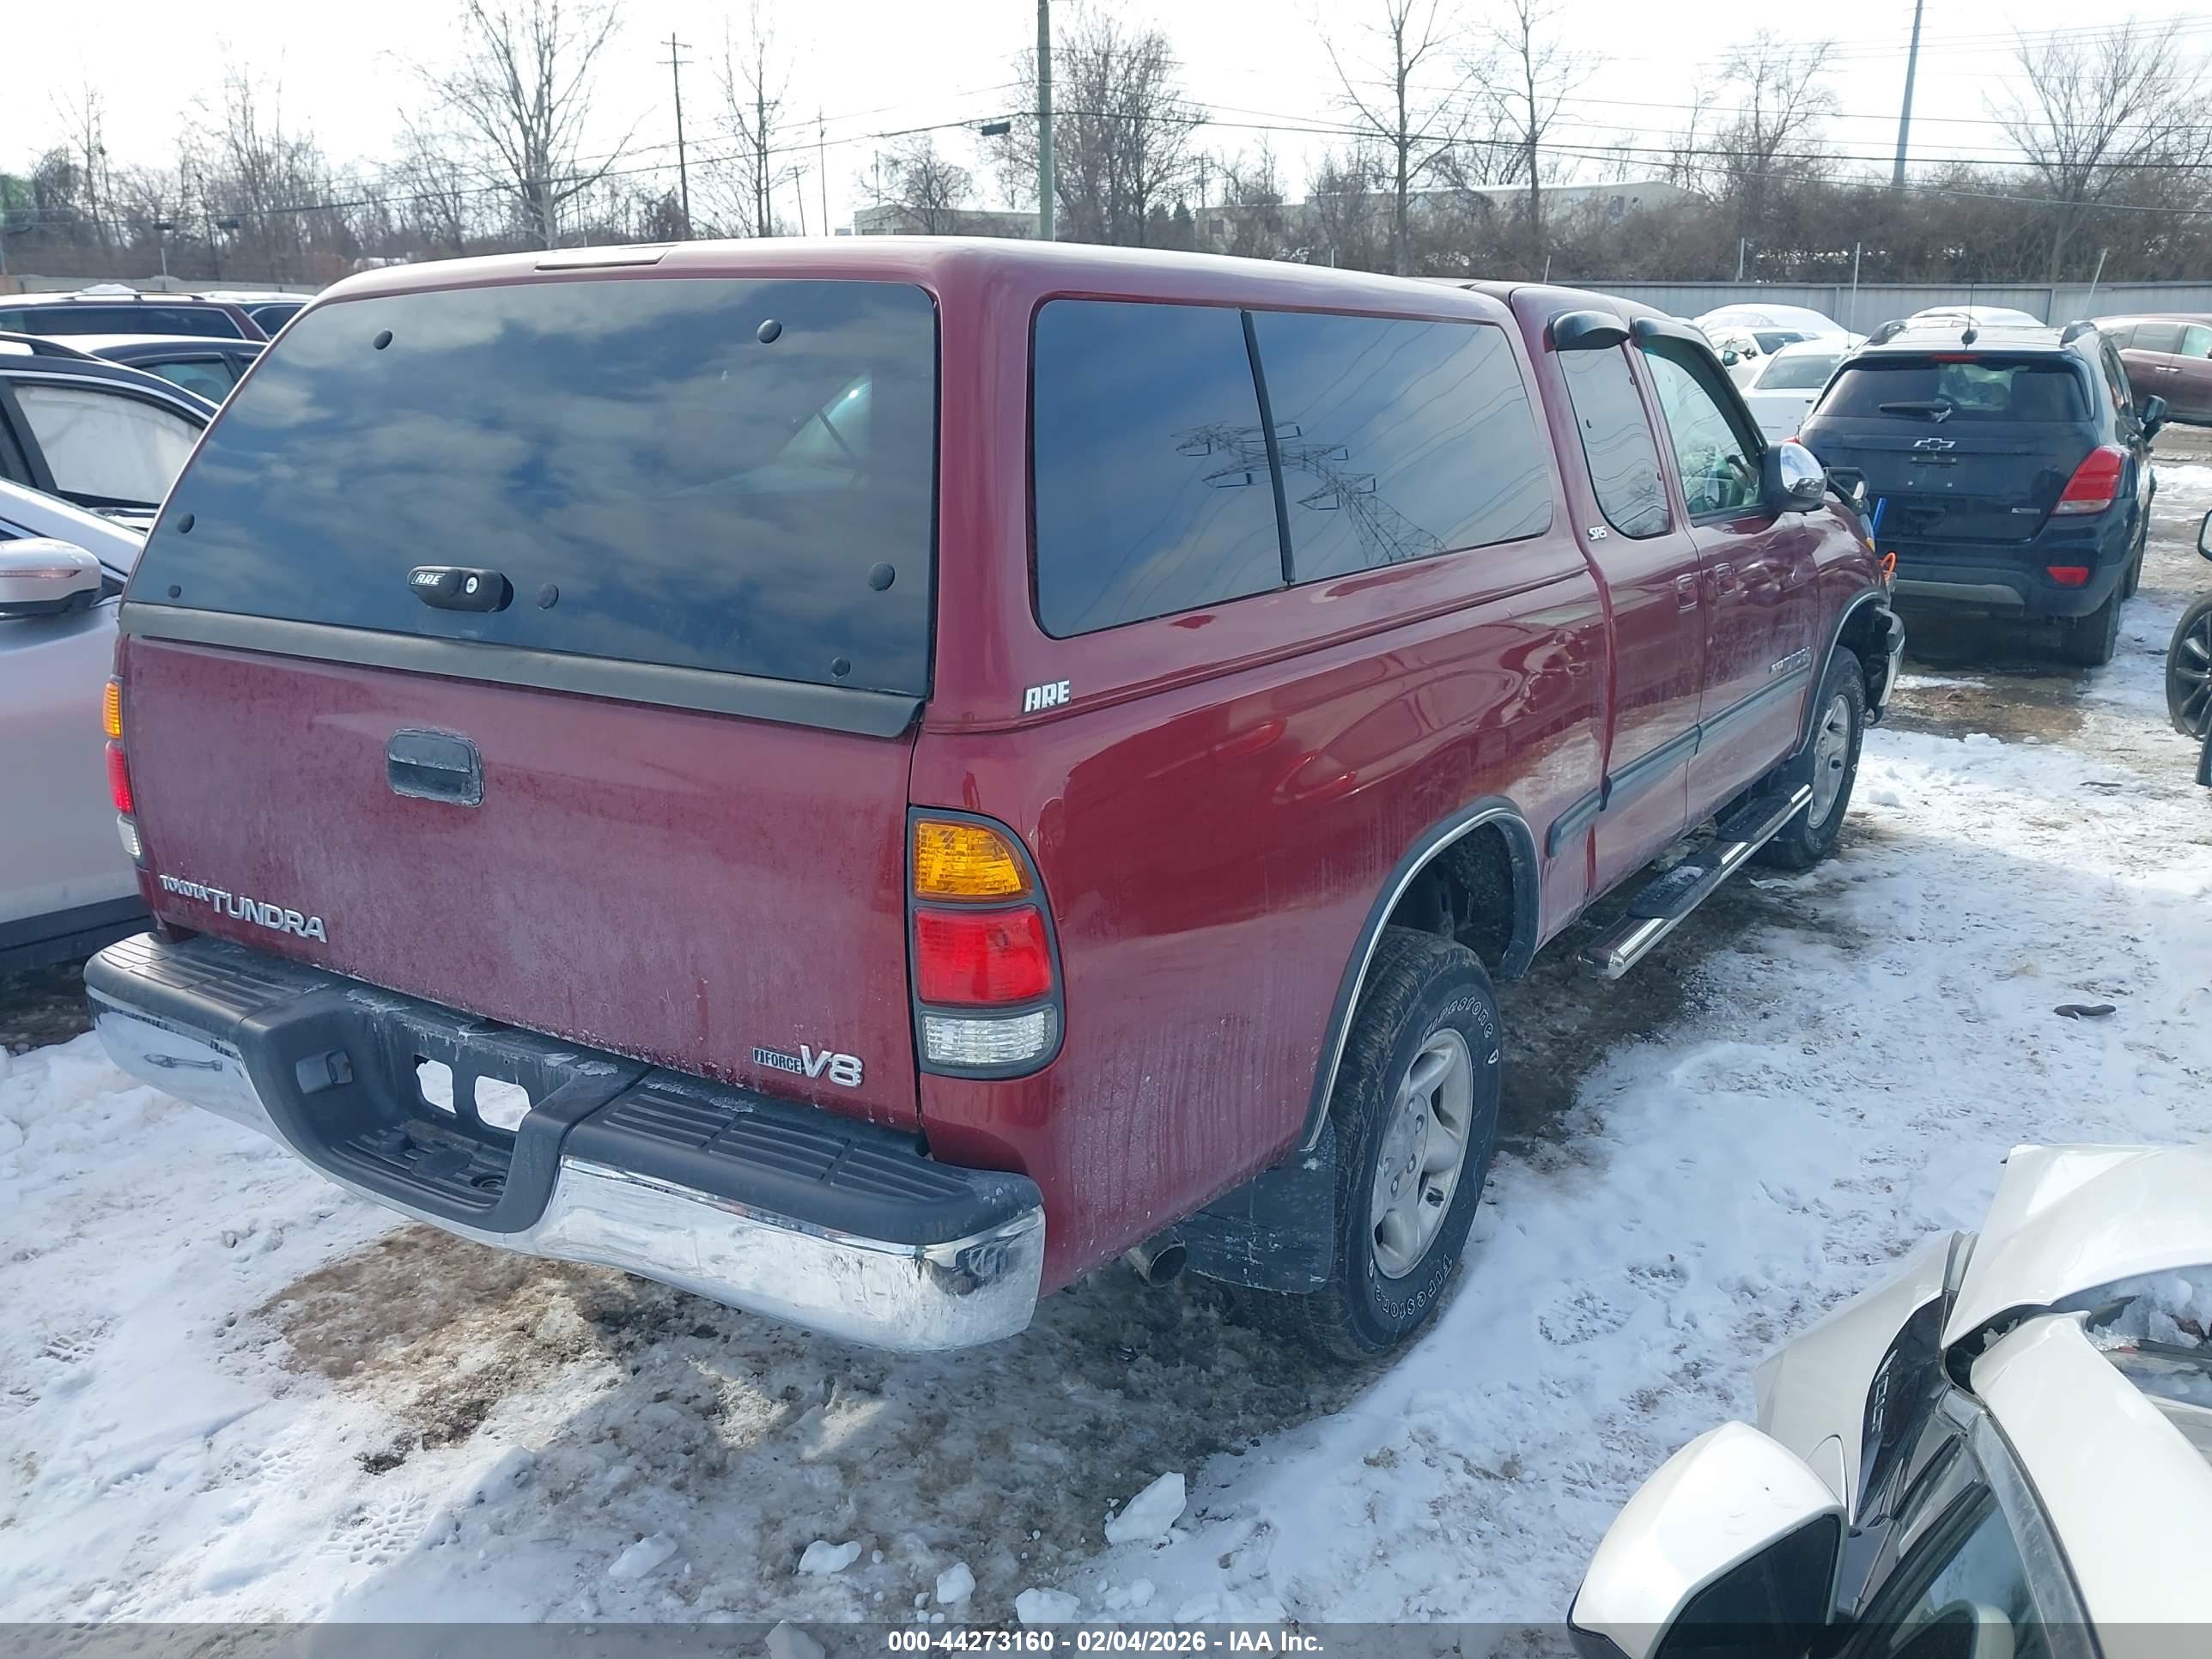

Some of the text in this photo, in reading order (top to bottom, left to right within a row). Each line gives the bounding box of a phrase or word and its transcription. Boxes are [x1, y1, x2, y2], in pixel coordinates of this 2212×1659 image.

[415, 574, 444, 586] ARE
[1024, 679, 1070, 713] ARE
[160, 874, 328, 944] TOYOTA TUNDRA
[799, 1044, 864, 1087] V8
